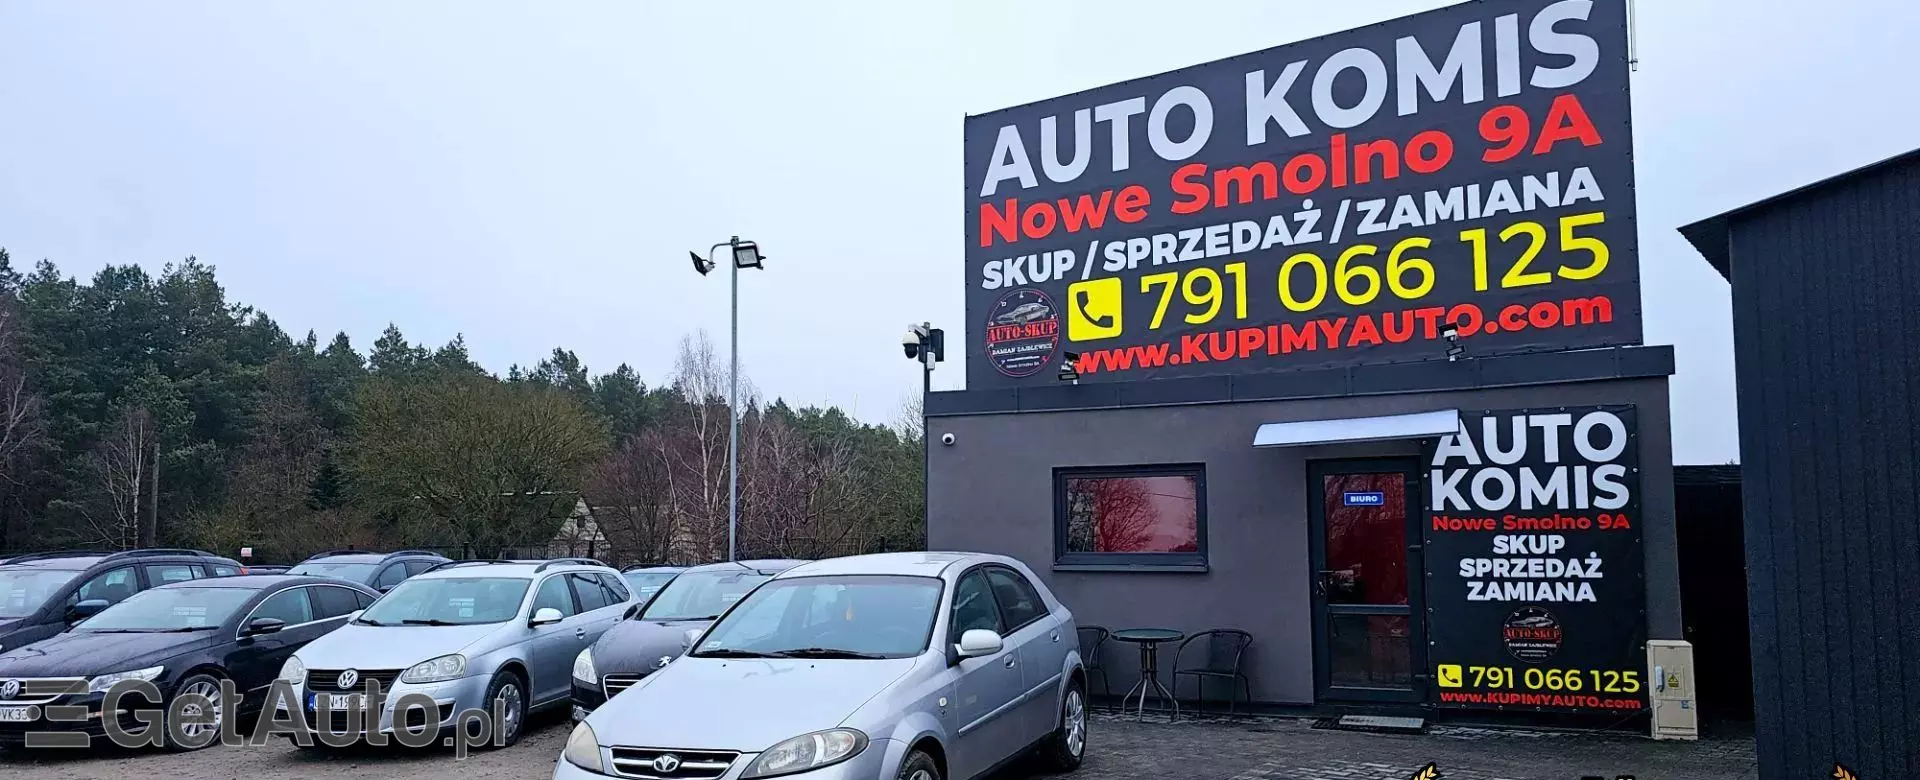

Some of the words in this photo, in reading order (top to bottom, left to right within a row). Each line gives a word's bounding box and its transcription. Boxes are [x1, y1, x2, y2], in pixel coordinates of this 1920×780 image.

[980, 85, 1214, 197] AUTO
[1246, 0, 1600, 146] KOMIS
[980, 184, 1150, 247] Nowe
[1171, 130, 1454, 214] Smolno
[1479, 94, 1603, 162] 9A
[981, 249, 1075, 290] SKUP
[1103, 198, 1322, 272] SPRZEDAŻ
[1356, 166, 1605, 235] ZAMIANA
[1140, 262, 1248, 330] 791
[1278, 237, 1435, 312] 066
[1460, 212, 1610, 292] 125
[989, 321, 1056, 341] AUTO-SKUP
[1074, 295, 1614, 375] www.KUPIMYAUTO.com
[1431, 411, 1628, 466] AUTO
[1350, 495, 1378, 503] BIURO
[1431, 464, 1630, 511] KOMIS
[1432, 515, 1497, 531] Nowe
[1503, 514, 1591, 530] Smolno
[1597, 513, 1631, 530] 9A
[1492, 535, 1565, 554] SKUP
[1459, 551, 1604, 578] SPRZEDAŻ
[1467, 581, 1598, 602] ZAMIANA
[1469, 666, 1514, 688] 791
[1524, 669, 1583, 690] 066
[1591, 671, 1641, 693] 125
[1440, 691, 1642, 709] www.KUPIMYAUTO.com
